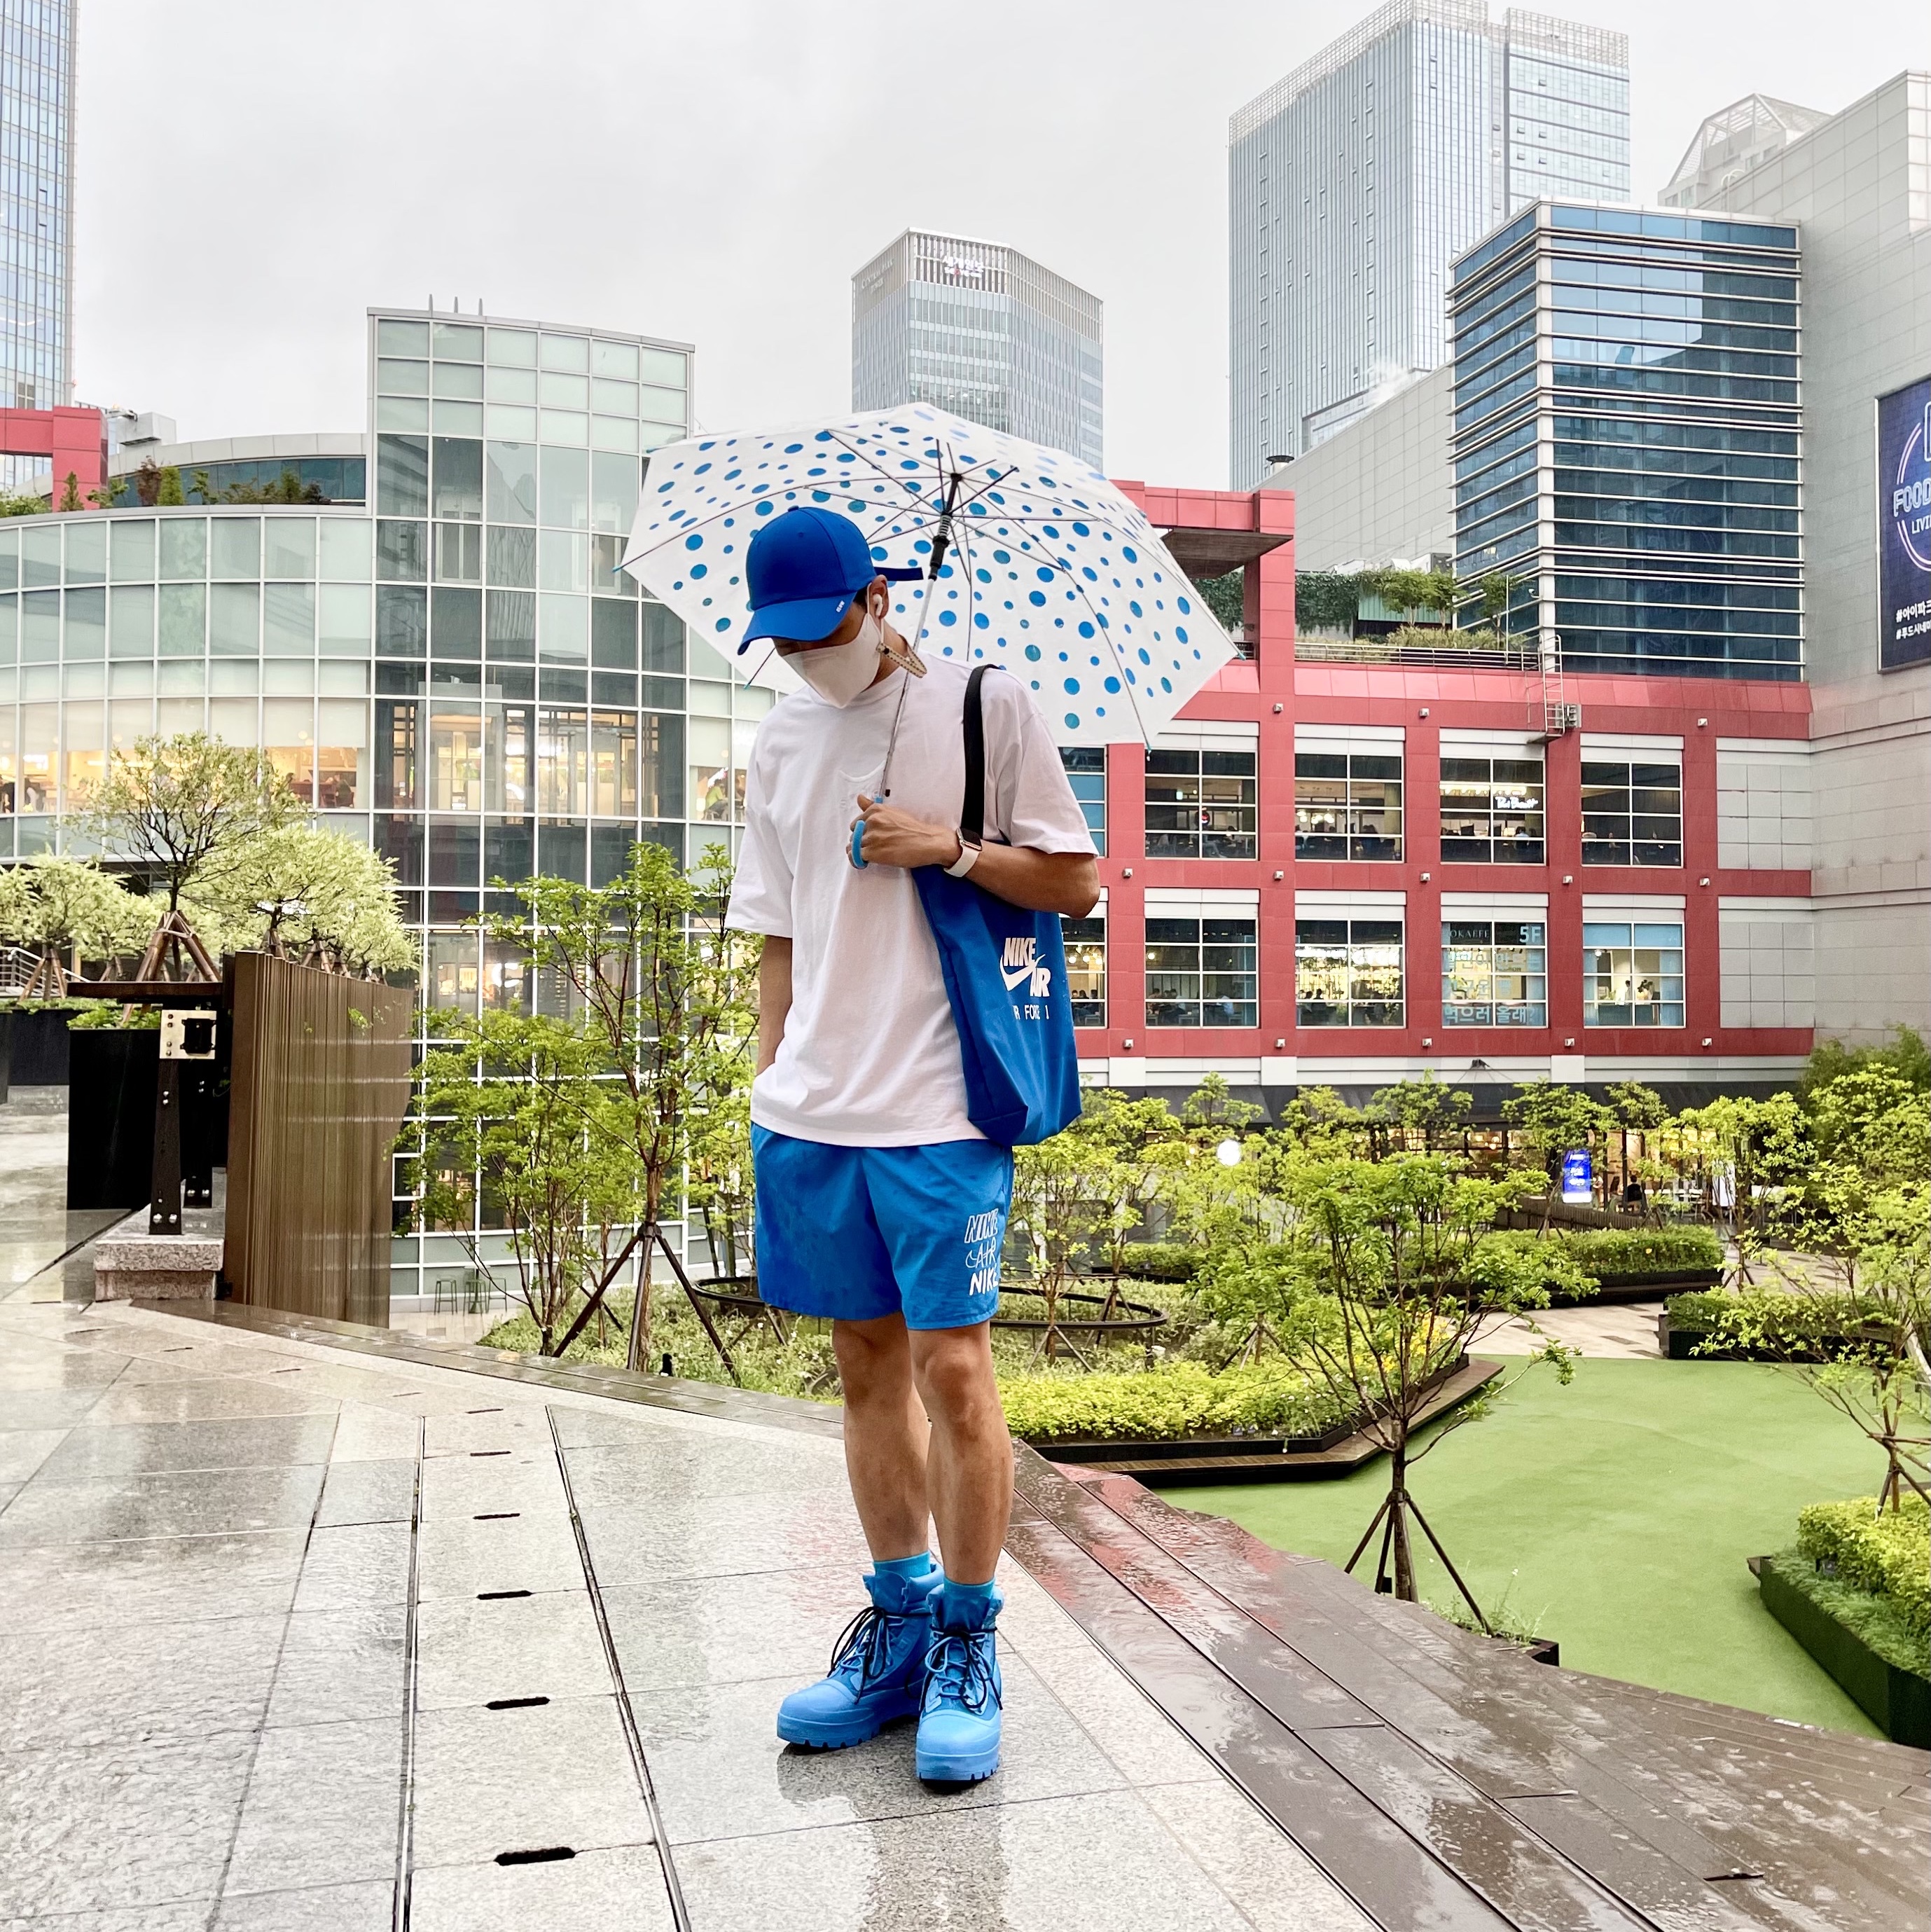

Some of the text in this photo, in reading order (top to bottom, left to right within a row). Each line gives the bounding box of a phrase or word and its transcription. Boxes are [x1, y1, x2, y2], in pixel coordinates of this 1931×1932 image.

[1893, 478, 1931, 517] FOOD
[1911, 514, 1931, 534] LIVI
[1519, 925, 1542, 943] 5F
[1003, 937, 1037, 967] NIKE
[1445, 1005, 1490, 1023] 먹으러
[969, 1263, 999, 1296] NIKE
